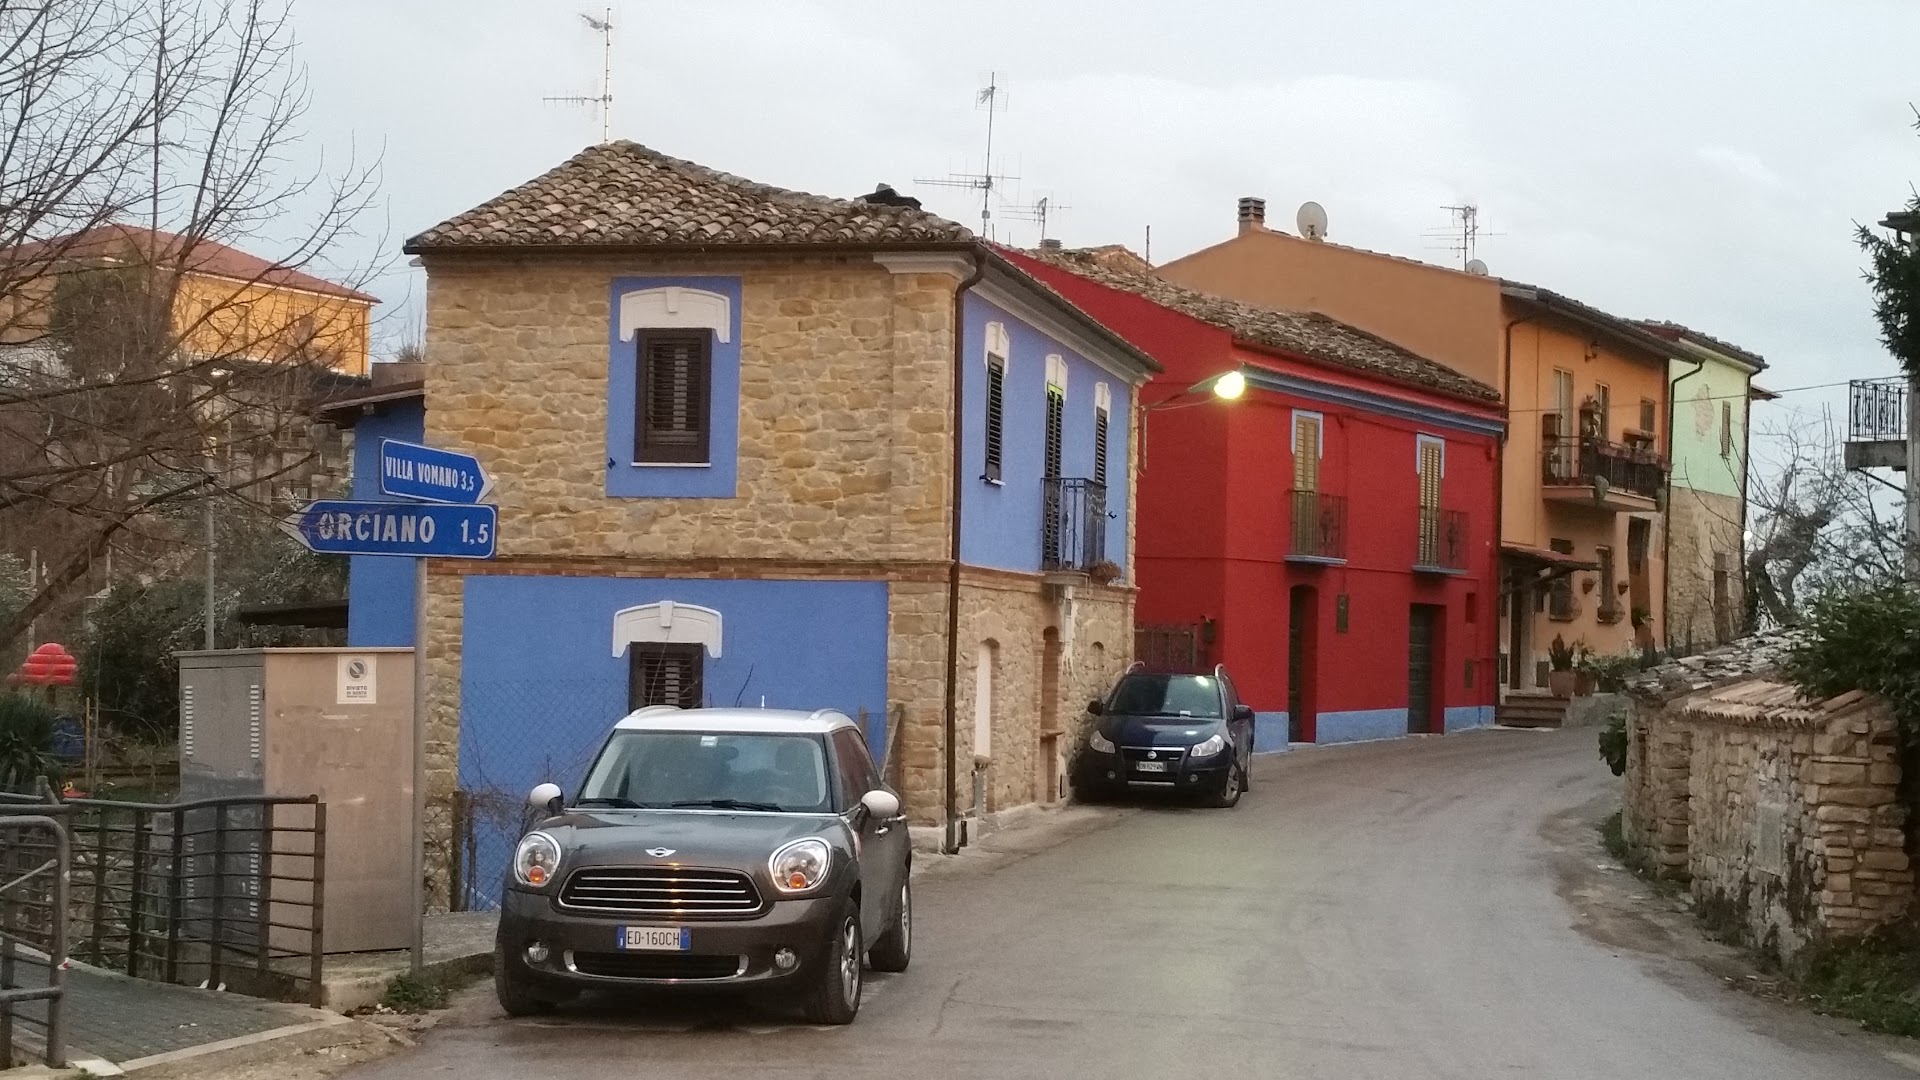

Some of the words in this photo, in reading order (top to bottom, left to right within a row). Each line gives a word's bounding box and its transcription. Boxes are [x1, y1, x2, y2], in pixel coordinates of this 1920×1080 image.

[385, 456, 413, 480] VILLA
[418, 462, 458, 488] VOMANO
[318, 512, 436, 543] ORCIANO
[461, 519, 488, 545] 1,5
